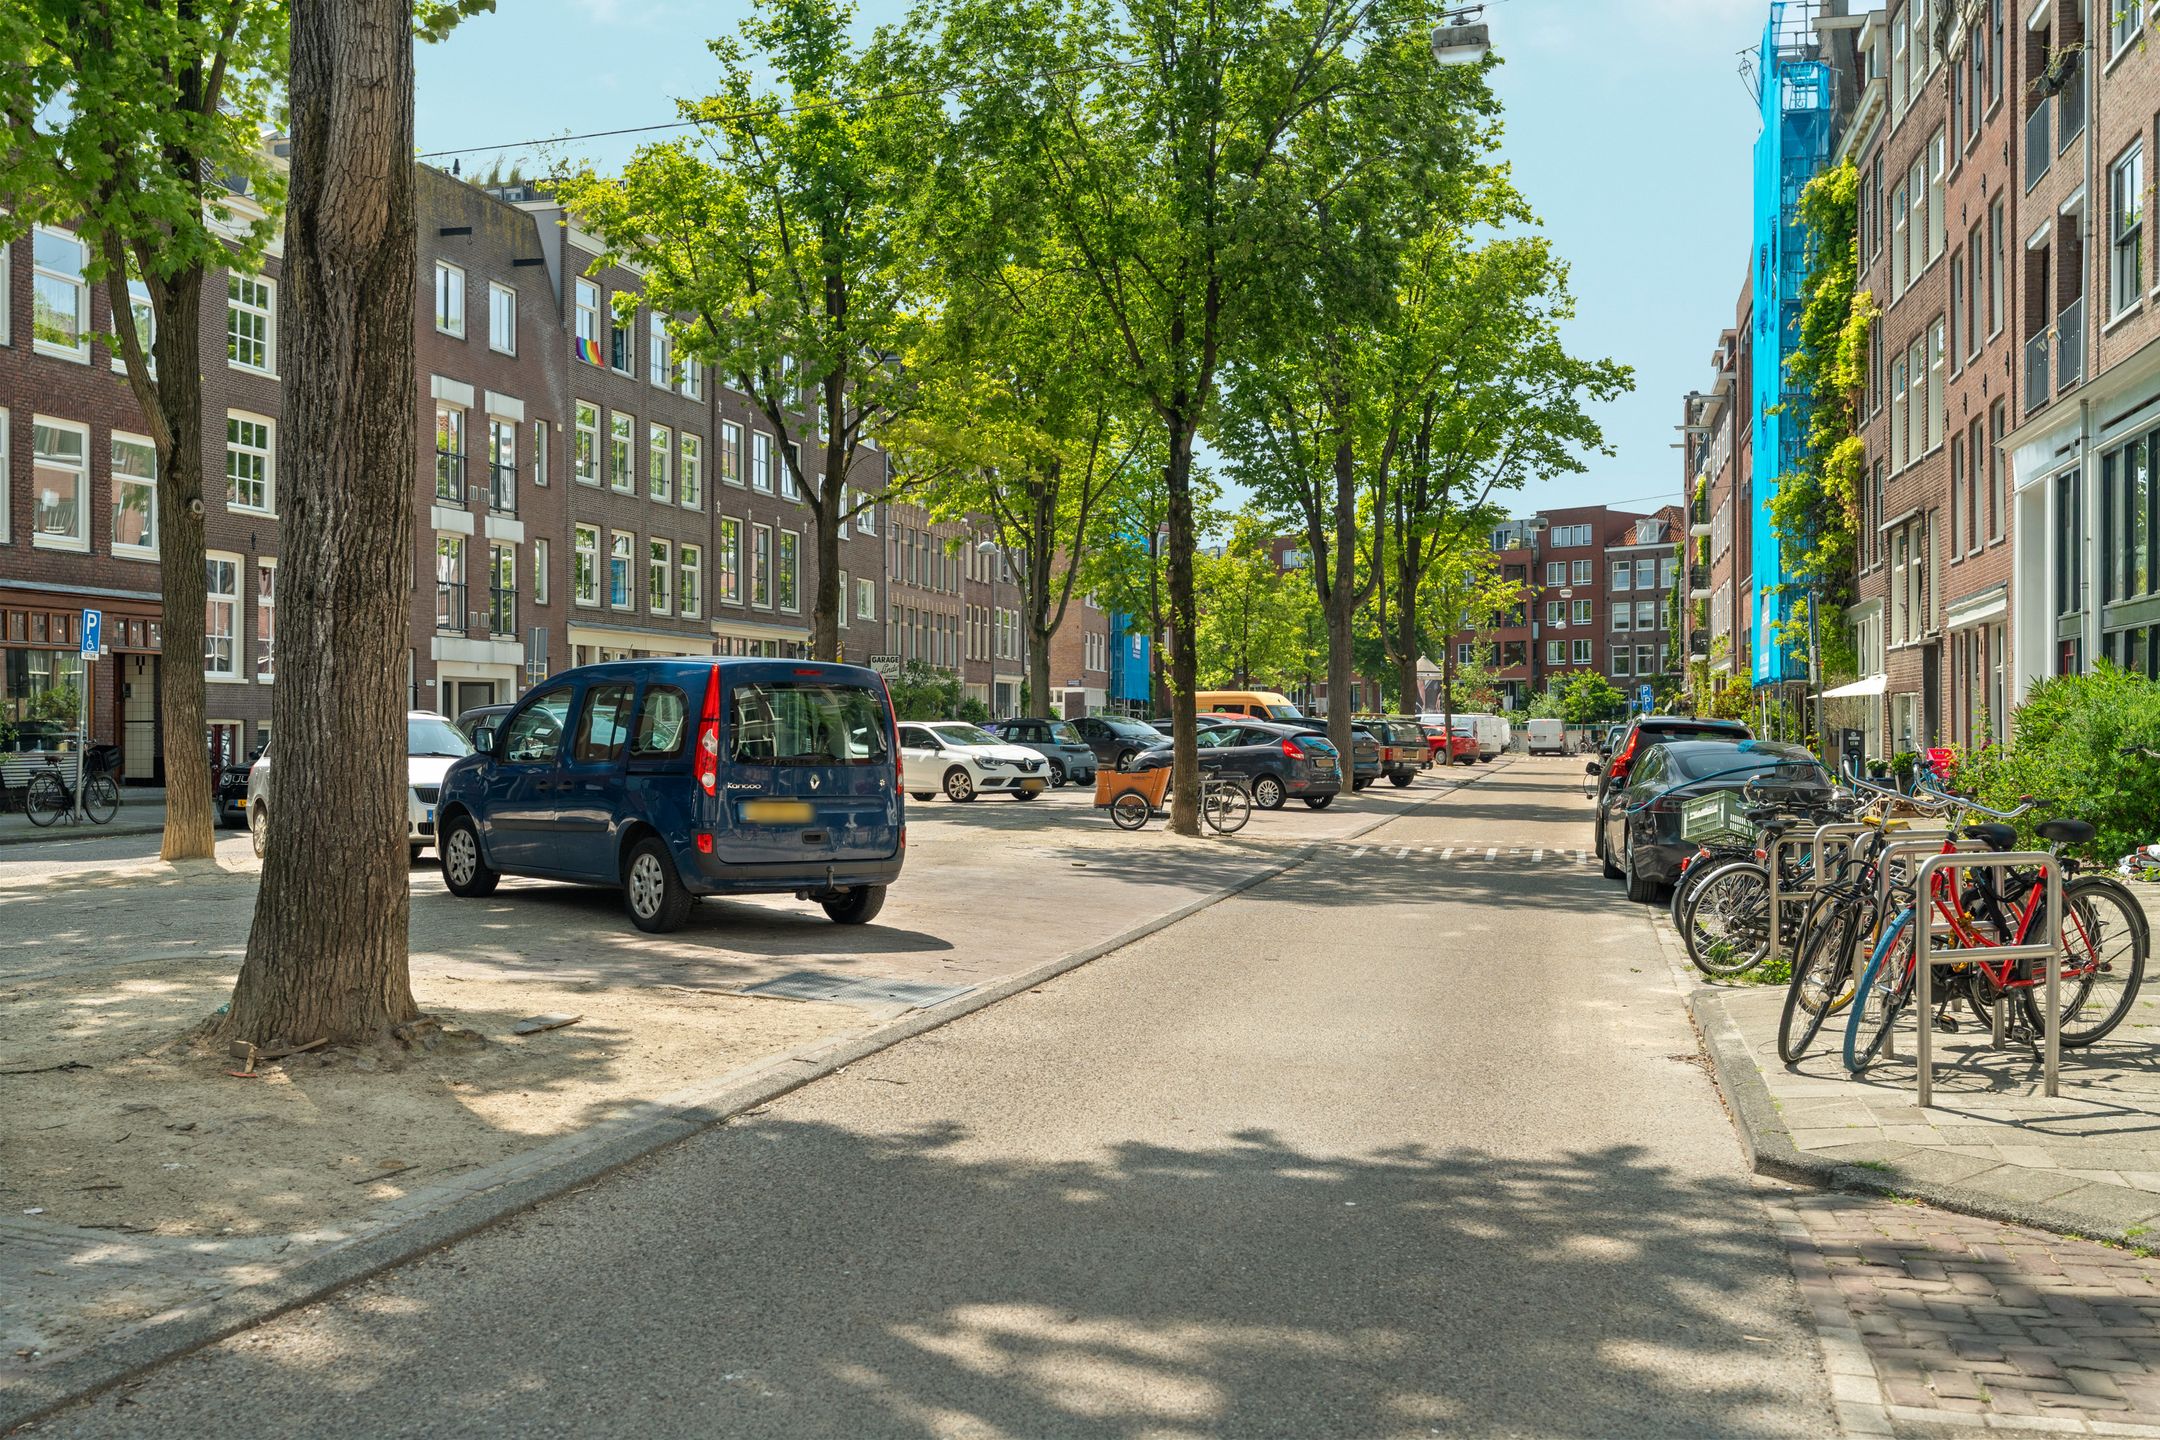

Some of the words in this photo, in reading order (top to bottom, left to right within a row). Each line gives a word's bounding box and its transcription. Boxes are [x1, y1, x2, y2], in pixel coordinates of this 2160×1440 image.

[86, 613, 97, 635] P
[1642, 686, 1649, 694] P
[1644, 697, 1651, 705] P
